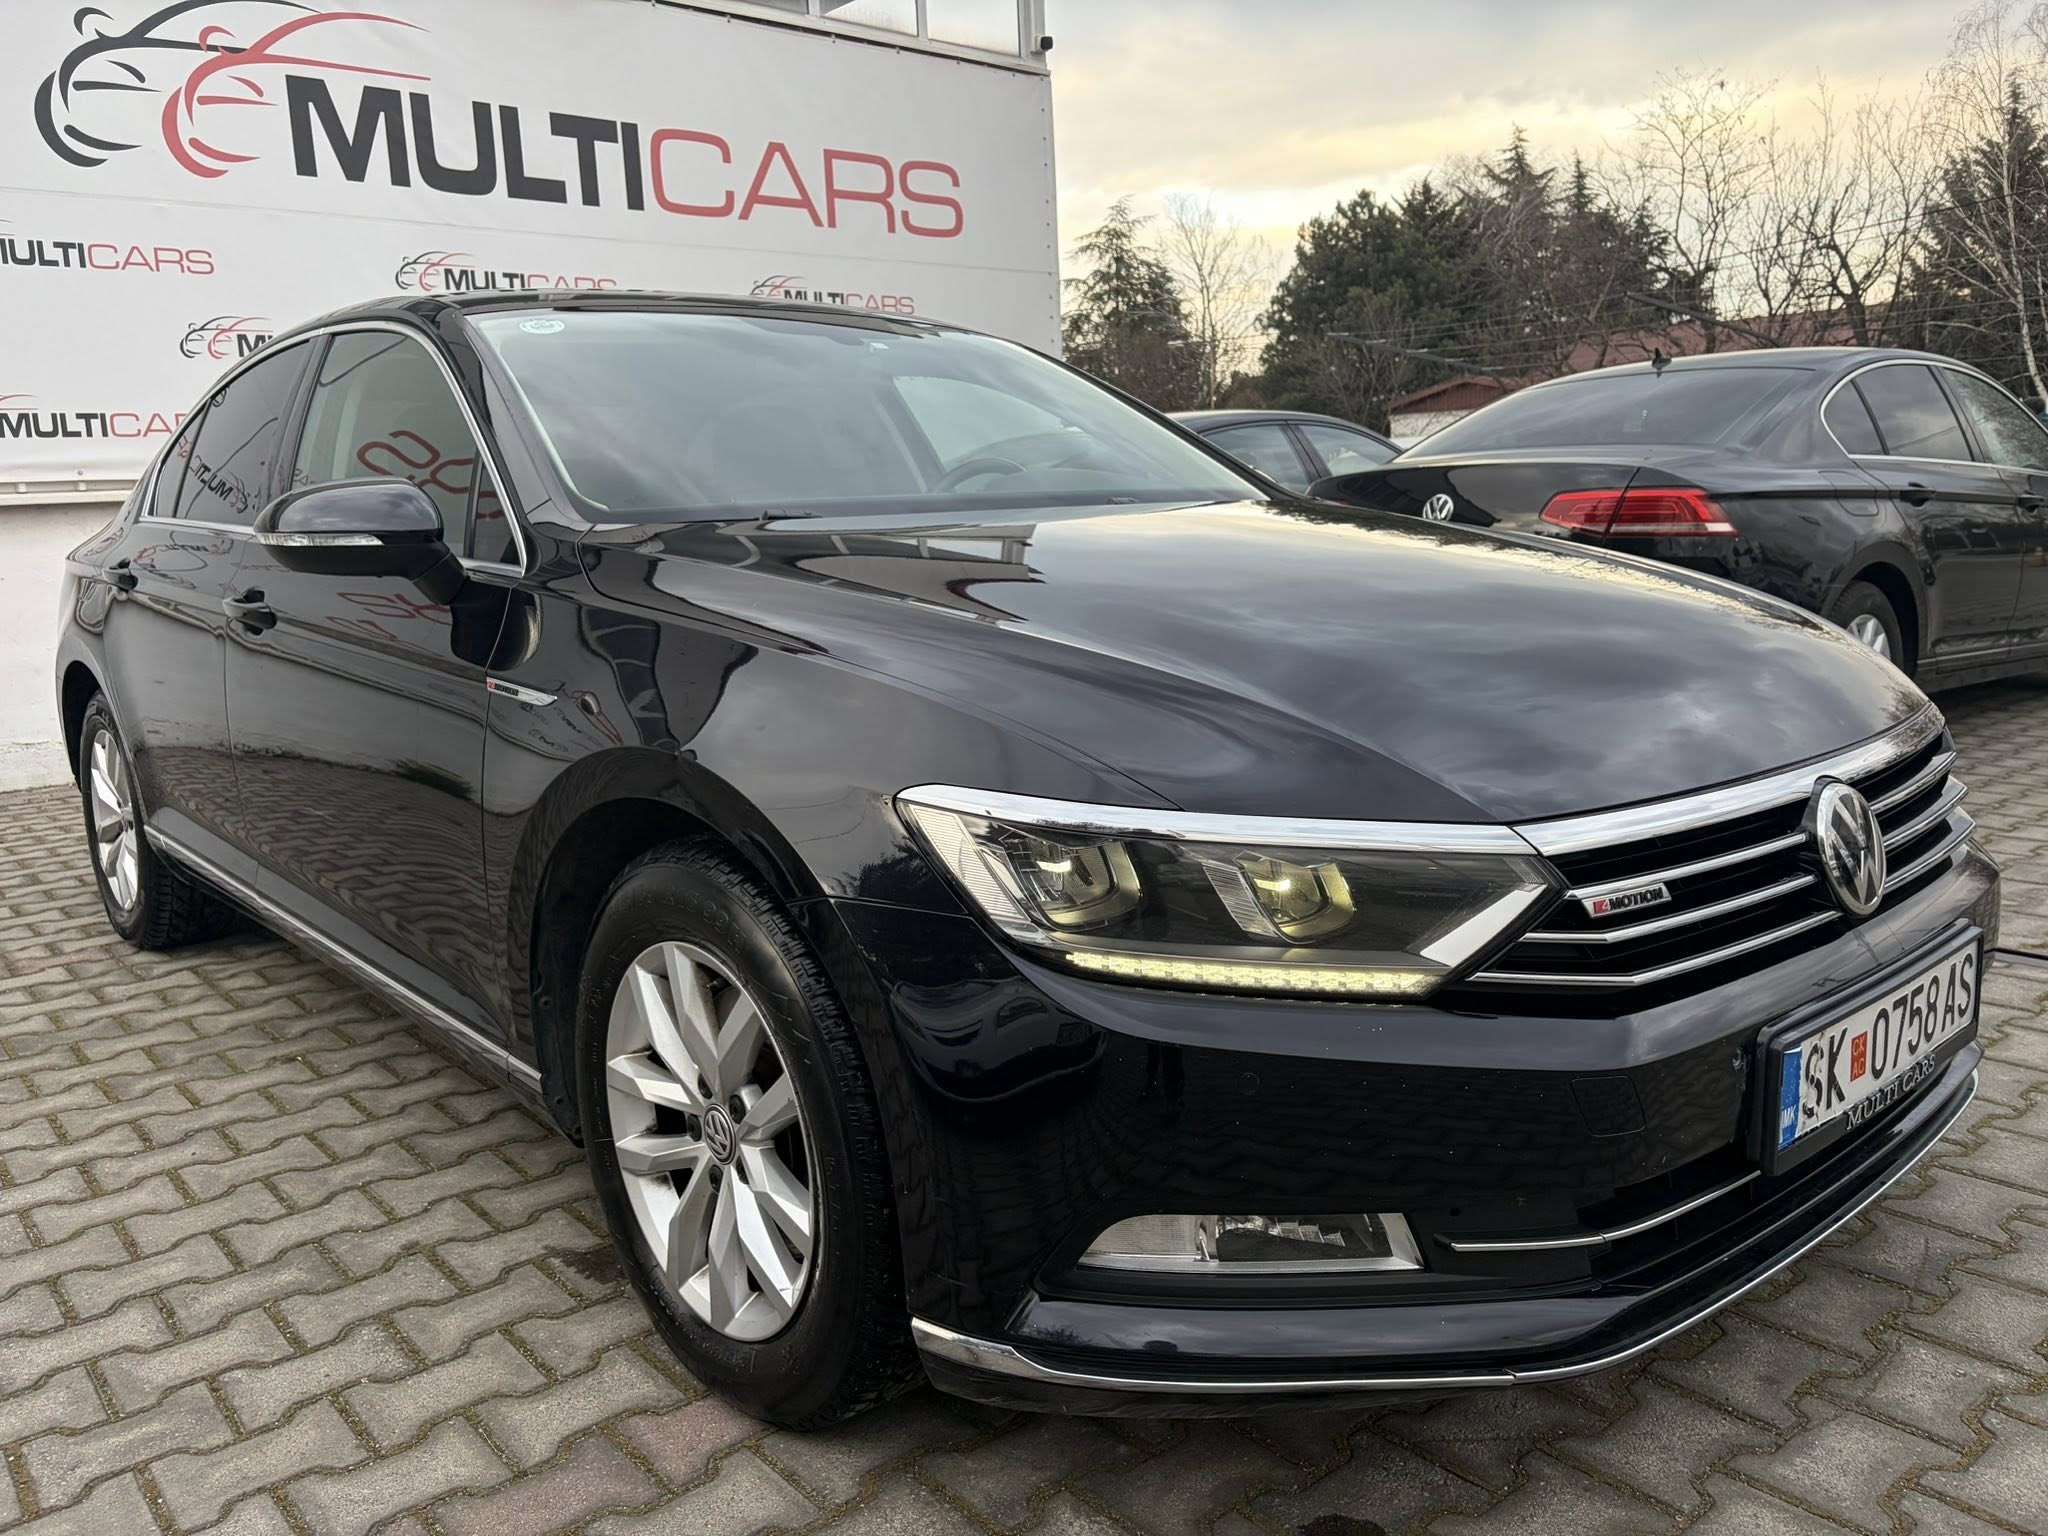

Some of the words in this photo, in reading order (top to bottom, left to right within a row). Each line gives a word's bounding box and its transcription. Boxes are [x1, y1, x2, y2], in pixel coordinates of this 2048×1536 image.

[285, 74, 964, 239] MULTICARS
[0, 238, 215, 275] ULTICARS
[1803, 1027, 1848, 1119] SK
[1846, 1080, 1899, 1130] MULTI
[1902, 1054, 1936, 1092] CARS
